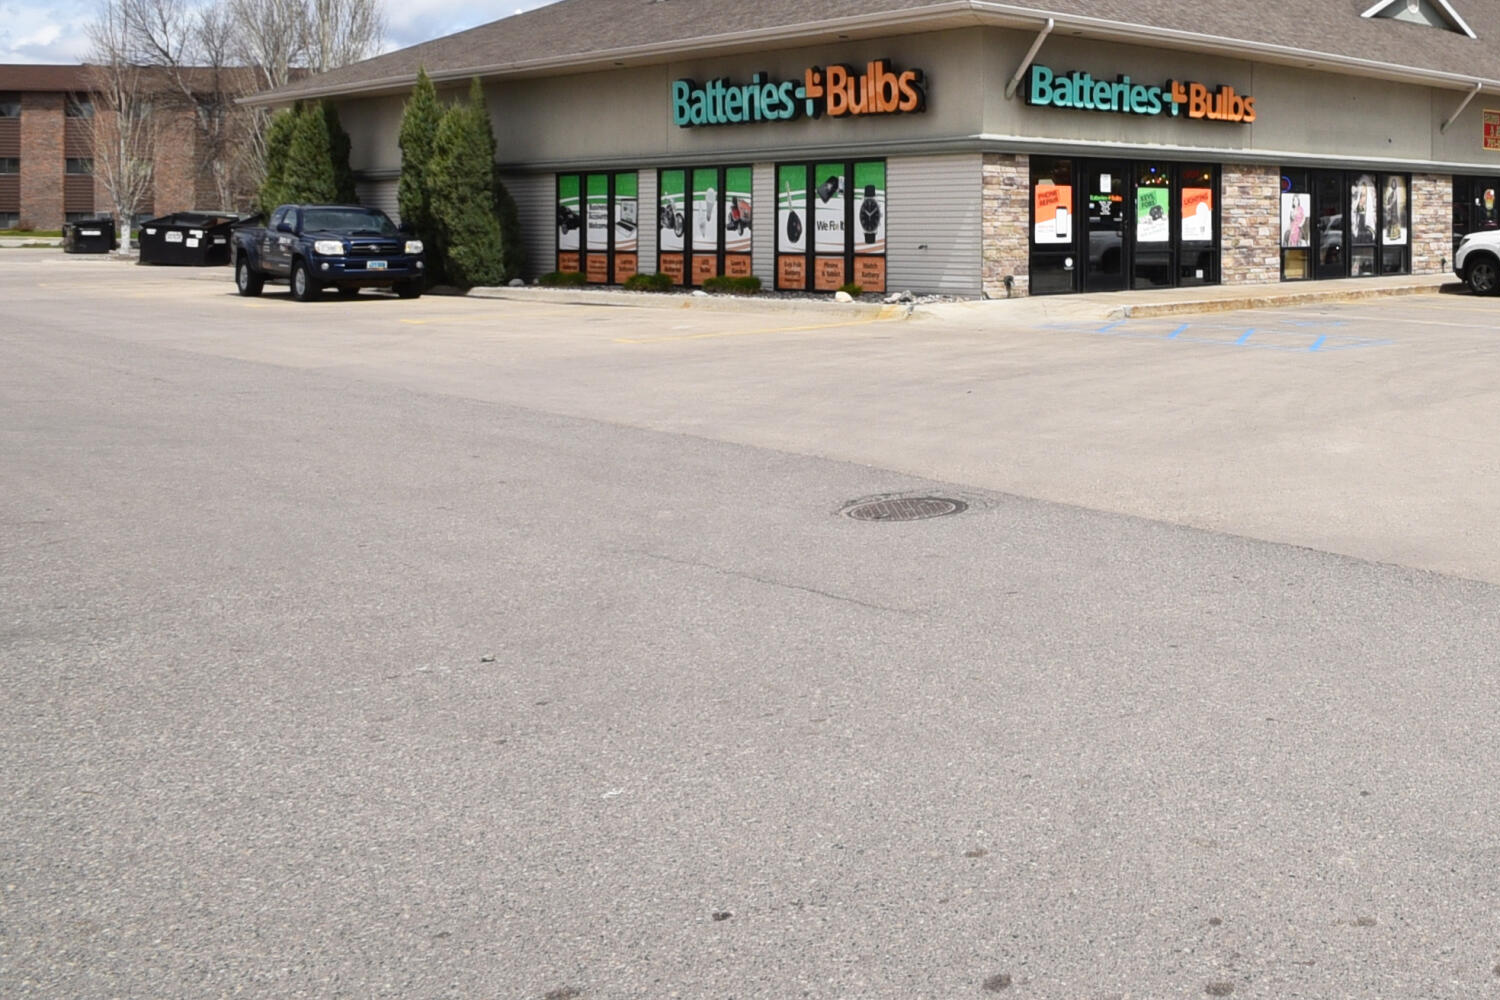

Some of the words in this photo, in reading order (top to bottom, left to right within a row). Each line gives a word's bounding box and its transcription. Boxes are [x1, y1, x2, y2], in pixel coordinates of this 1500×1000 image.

[671, 73, 796, 126] Batteries
[826, 60, 918, 117] Bulbs
[1031, 65, 1162, 115] Batteries
[1189, 82, 1257, 123] Bulbs
